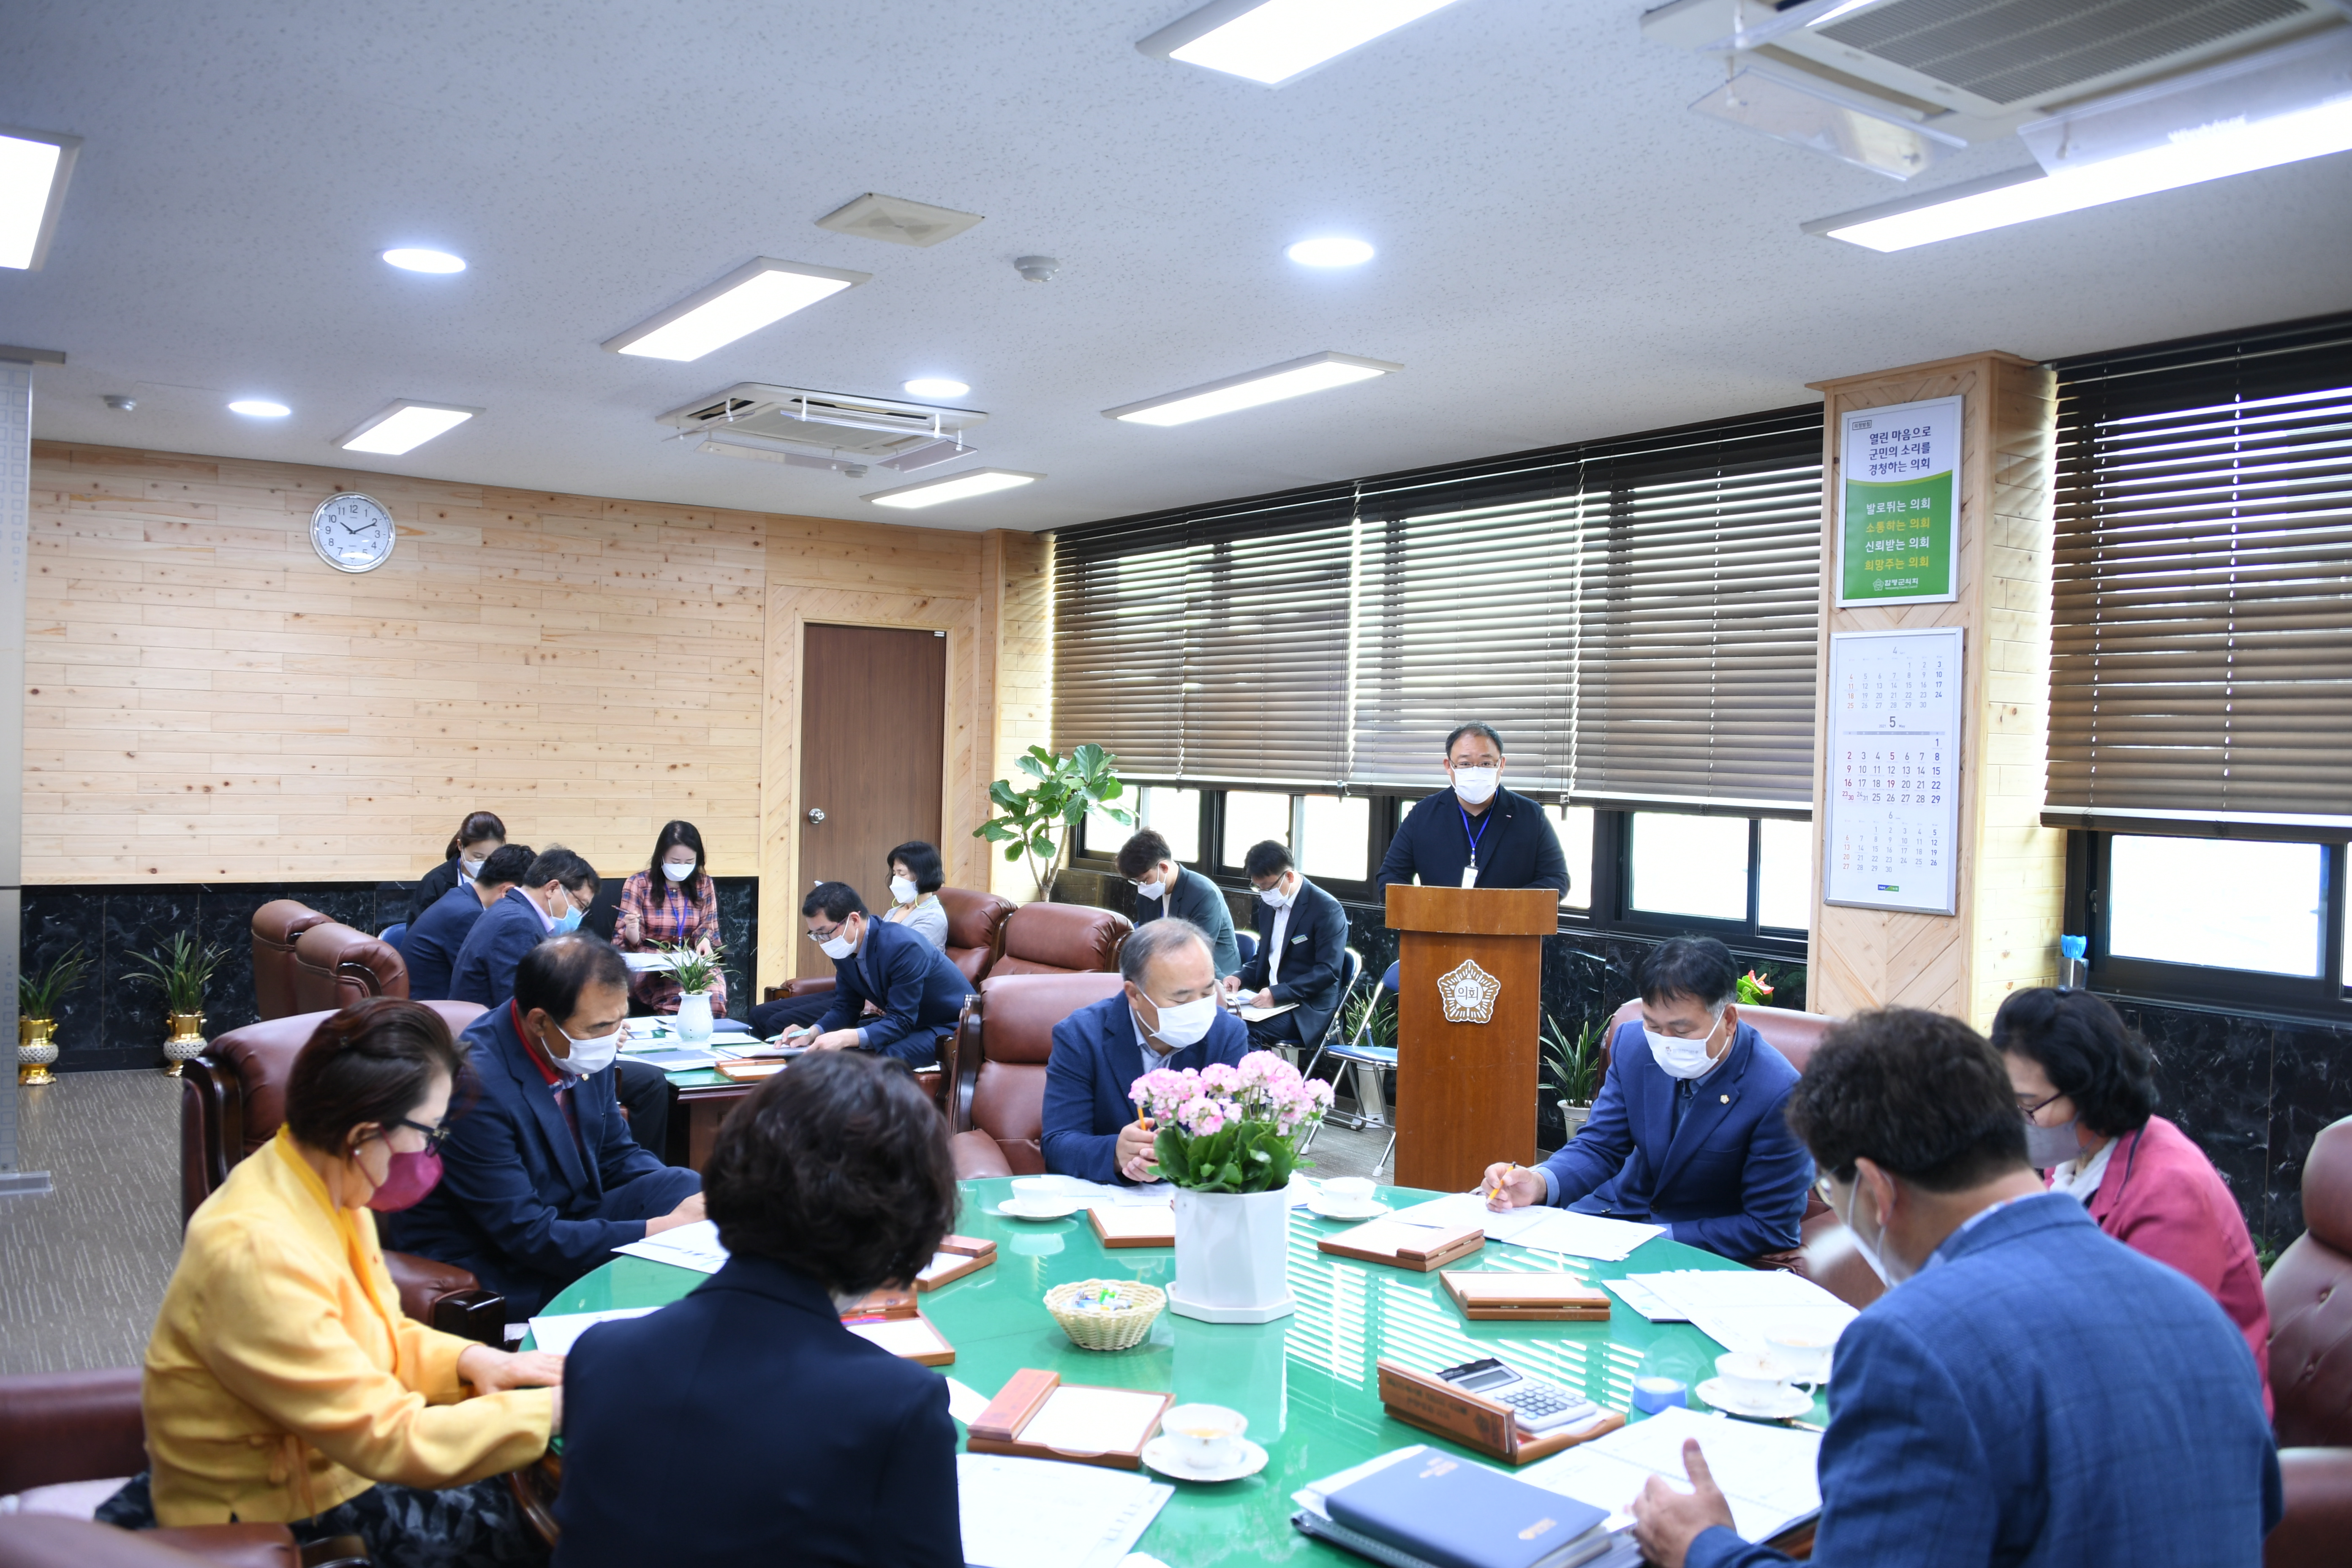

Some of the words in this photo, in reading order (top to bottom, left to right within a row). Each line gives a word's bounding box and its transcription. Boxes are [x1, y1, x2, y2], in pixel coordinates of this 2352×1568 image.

[1870, 432, 1888, 445] 열린
[1892, 426, 1931, 441] 마음으로
[1869, 446, 1897, 460] 군민의
[1901, 442, 1930, 455] 소리를
[1869, 461, 1907, 476] 경청하는
[1910, 457, 1930, 470] 의회
[350, 505, 358, 513] 12
[1867, 501, 1906, 515] 발로뛰는
[1910, 497, 1930, 510] 의회
[338, 507, 345, 515] 11
[365, 509, 368, 517] 1
[328, 514, 337, 523] 10
[372, 518, 377, 526] 2
[1865, 520, 1906, 533] 소통하는
[1909, 517, 1930, 530] 의회
[325, 526, 331, 534] 9
[375, 530, 380, 538] 3
[328, 538, 334, 546] 8
[371, 542, 377, 550] 4
[1865, 539, 1905, 553] 신뢰받는
[1909, 536, 1930, 549] 의회
[338, 547, 343, 555] 7
[1865, 558, 1905, 571] 희망주는
[1908, 556, 1929, 569] 의회
[1885, 578, 1918, 586] 함평군의회
[1889, 716, 1896, 728] 5
[1936, 738, 1938, 746] 1
[1890, 752, 1895, 760] 5
[1847, 765, 1851, 773] 9
[1888, 766, 1895, 774] 12
[1903, 766, 1910, 774] 13
[1931, 781, 1941, 789] 22
[1886, 794, 1895, 802] 26
[1931, 795, 1940, 803] 29
[1457, 986, 1478, 1001] 의회
